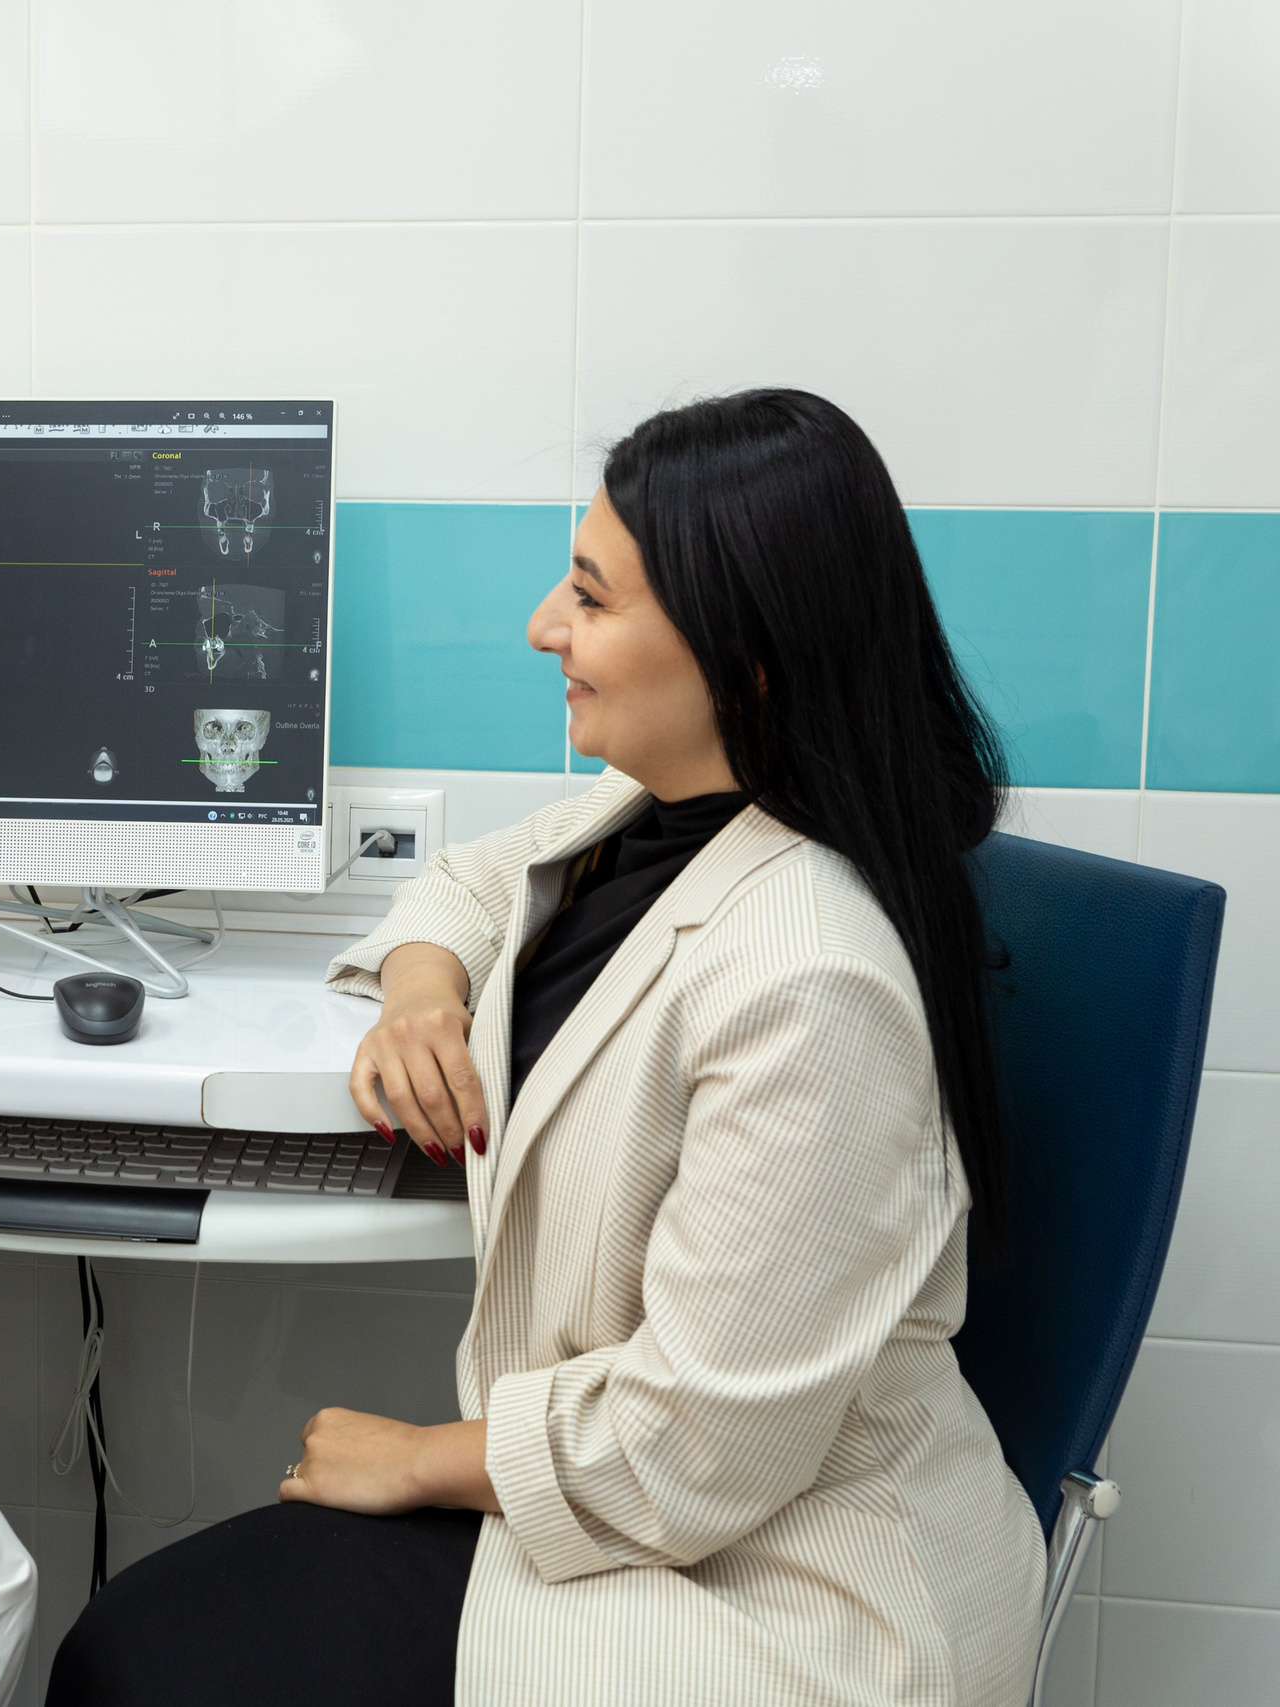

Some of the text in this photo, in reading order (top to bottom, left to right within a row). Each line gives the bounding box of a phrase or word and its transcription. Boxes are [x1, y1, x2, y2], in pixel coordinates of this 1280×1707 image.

[152, 452, 182, 460] Coronal
[153, 522, 161, 531] R
[135, 531, 142, 539] L
[148, 568, 177, 577] Sagittal
[149, 639, 157, 648] A
[144, 685, 155, 693] 3D
[275, 722, 298, 731] Outline
